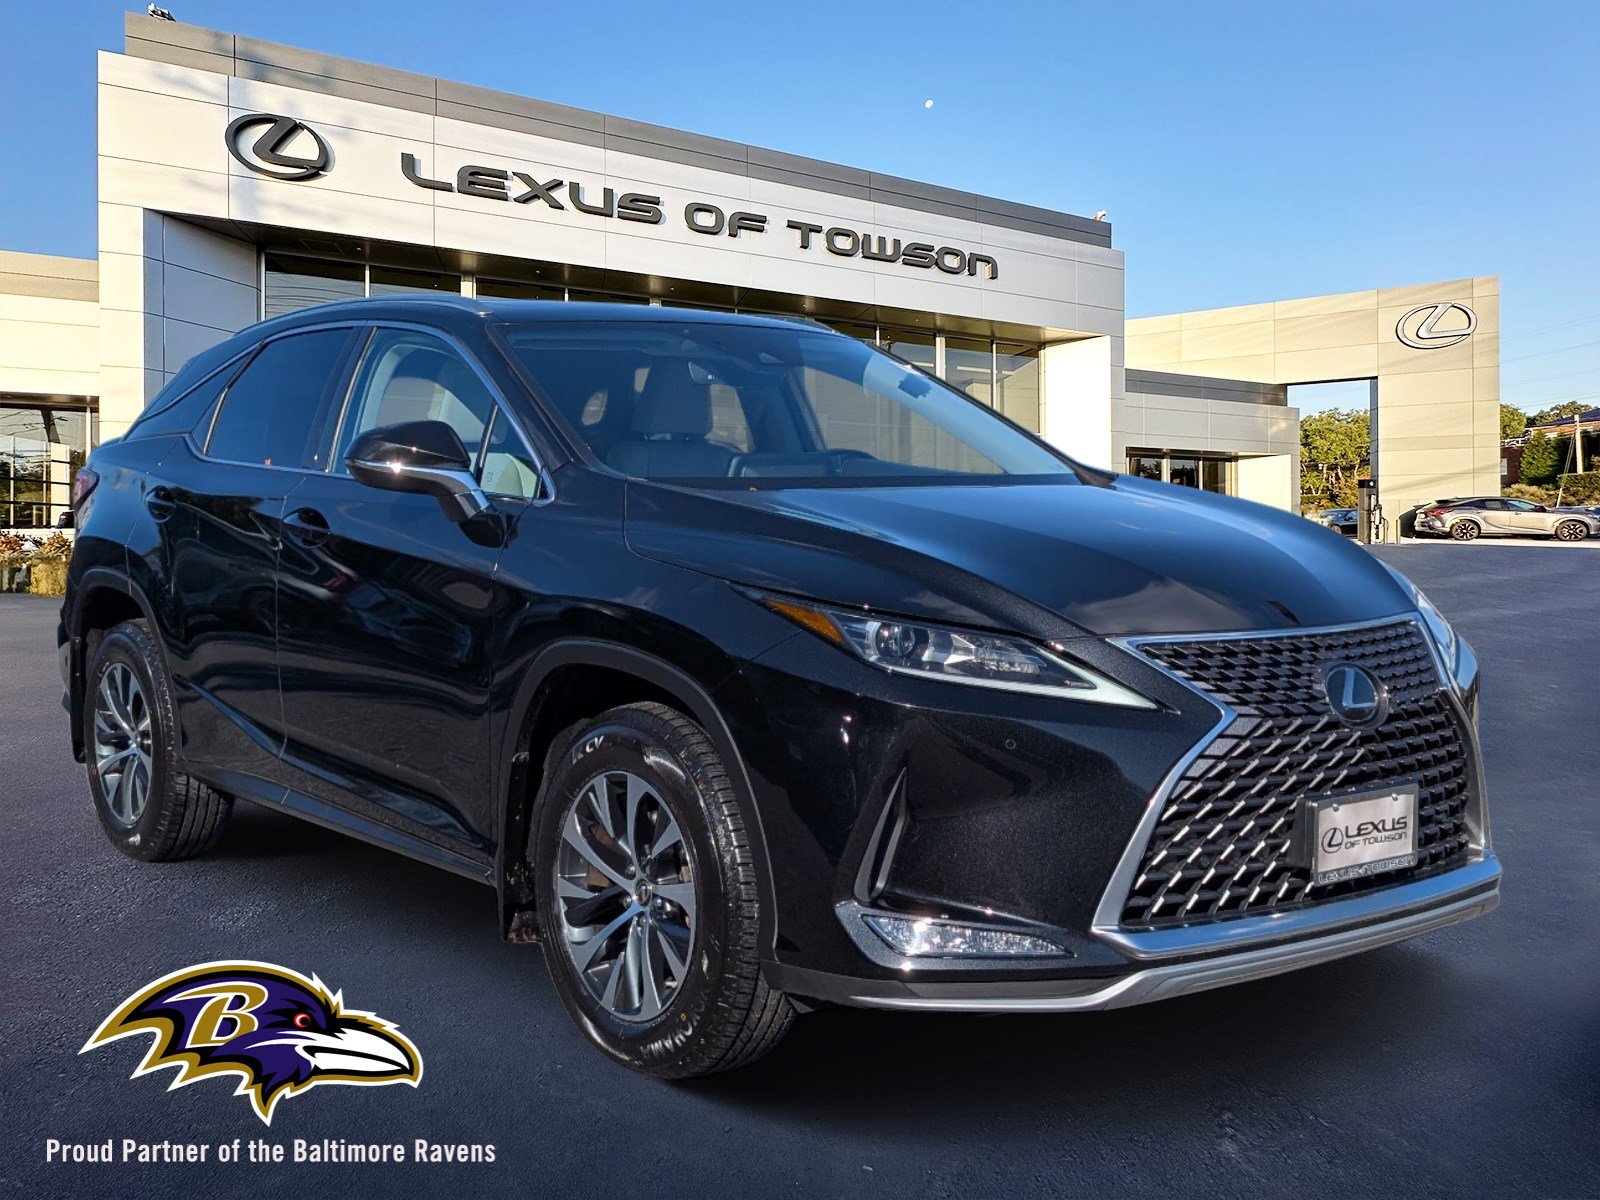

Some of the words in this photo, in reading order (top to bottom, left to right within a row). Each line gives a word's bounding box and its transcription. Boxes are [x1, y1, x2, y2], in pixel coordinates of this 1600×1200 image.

[400, 152, 663, 225] LEXUS
[684, 201, 767, 238] OF
[786, 219, 999, 280] TOWSON
[1345, 816, 1408, 839] LEXUS
[1344, 840, 1361, 850] OF
[1362, 831, 1408, 846] TOWSON
[1318, 868, 1359, 885] LEXUS
